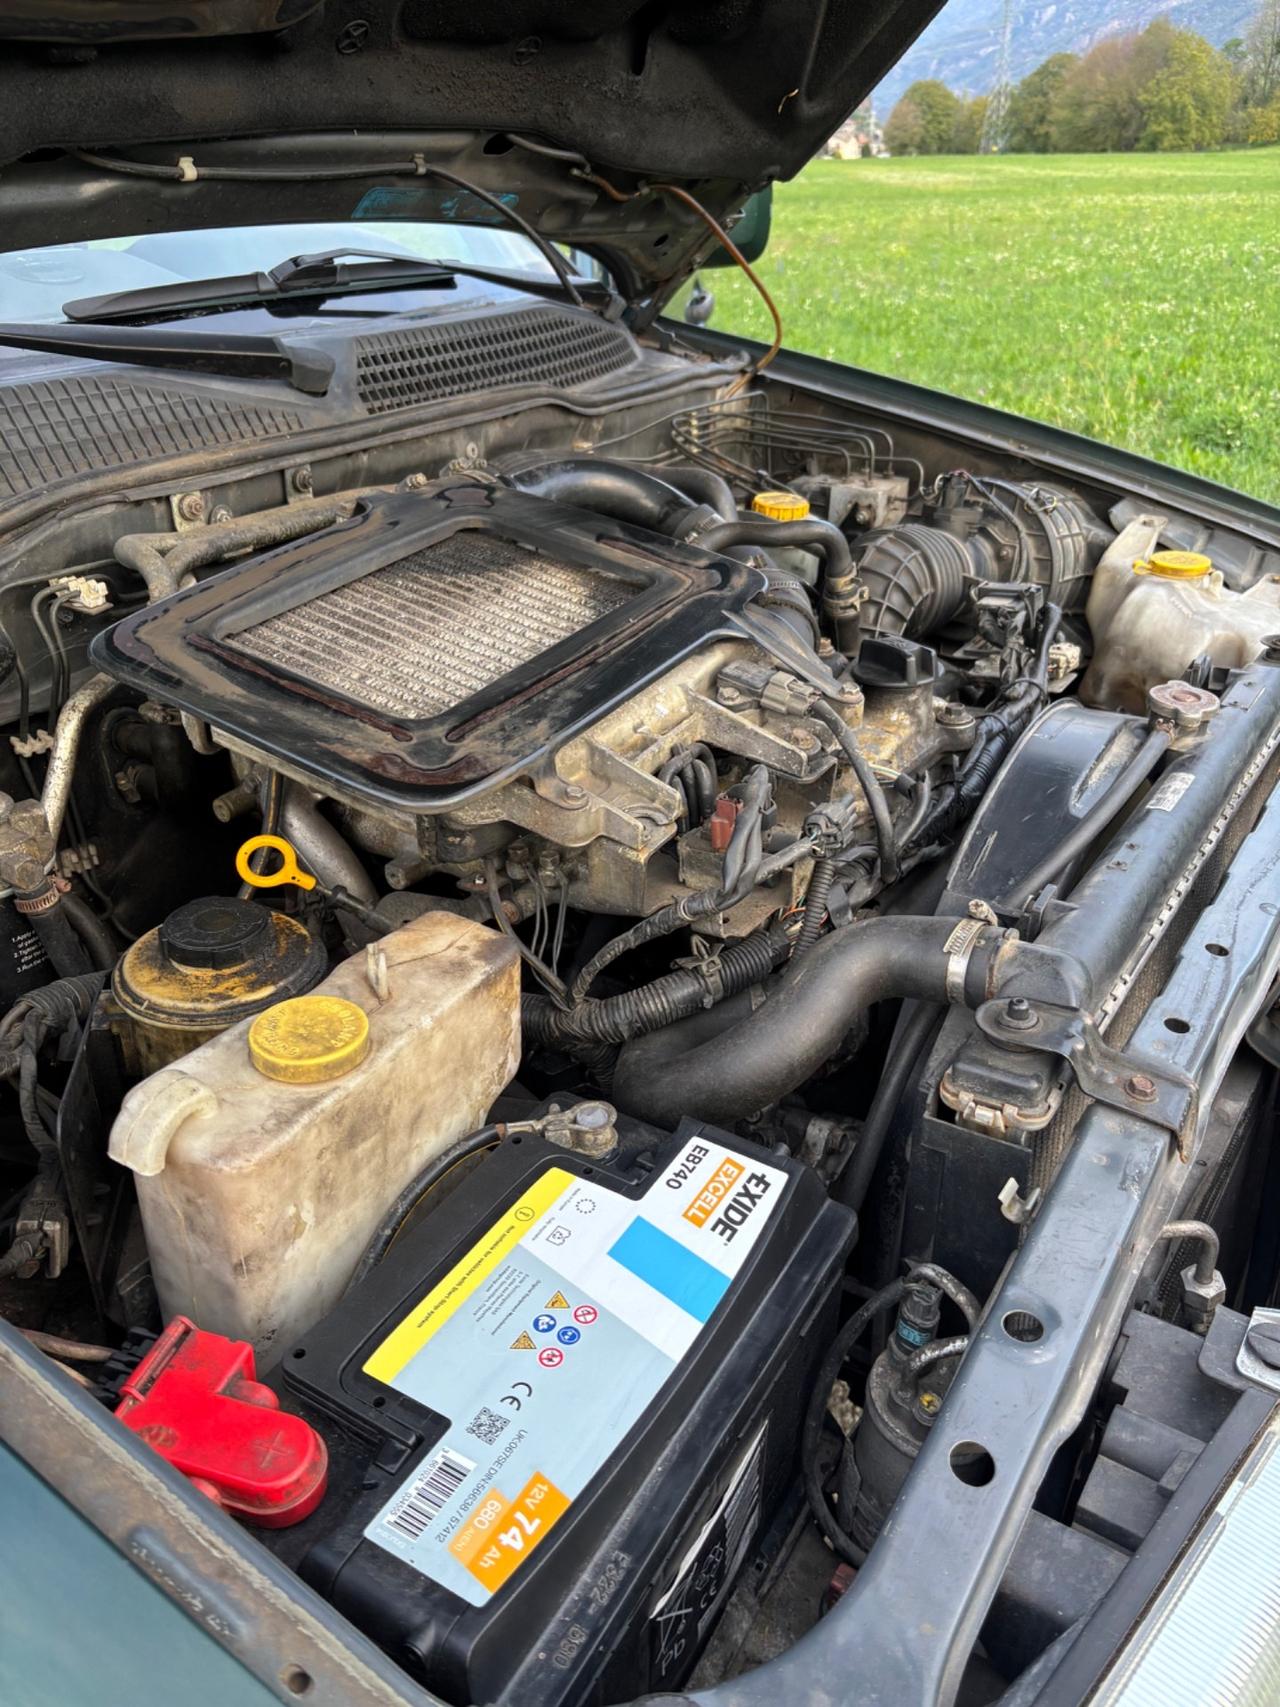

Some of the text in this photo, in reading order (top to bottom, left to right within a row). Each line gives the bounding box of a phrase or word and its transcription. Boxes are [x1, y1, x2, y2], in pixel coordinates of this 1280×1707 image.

[666, 1144, 710, 1188] EB740
[686, 1162, 739, 1220] EXCELL
[711, 1172, 771, 1242] EXIDE
[434, 1515, 460, 1543] 57412
[474, 1500, 500, 1527] 680
[478, 1482, 547, 1569] 12V 74 Ah
